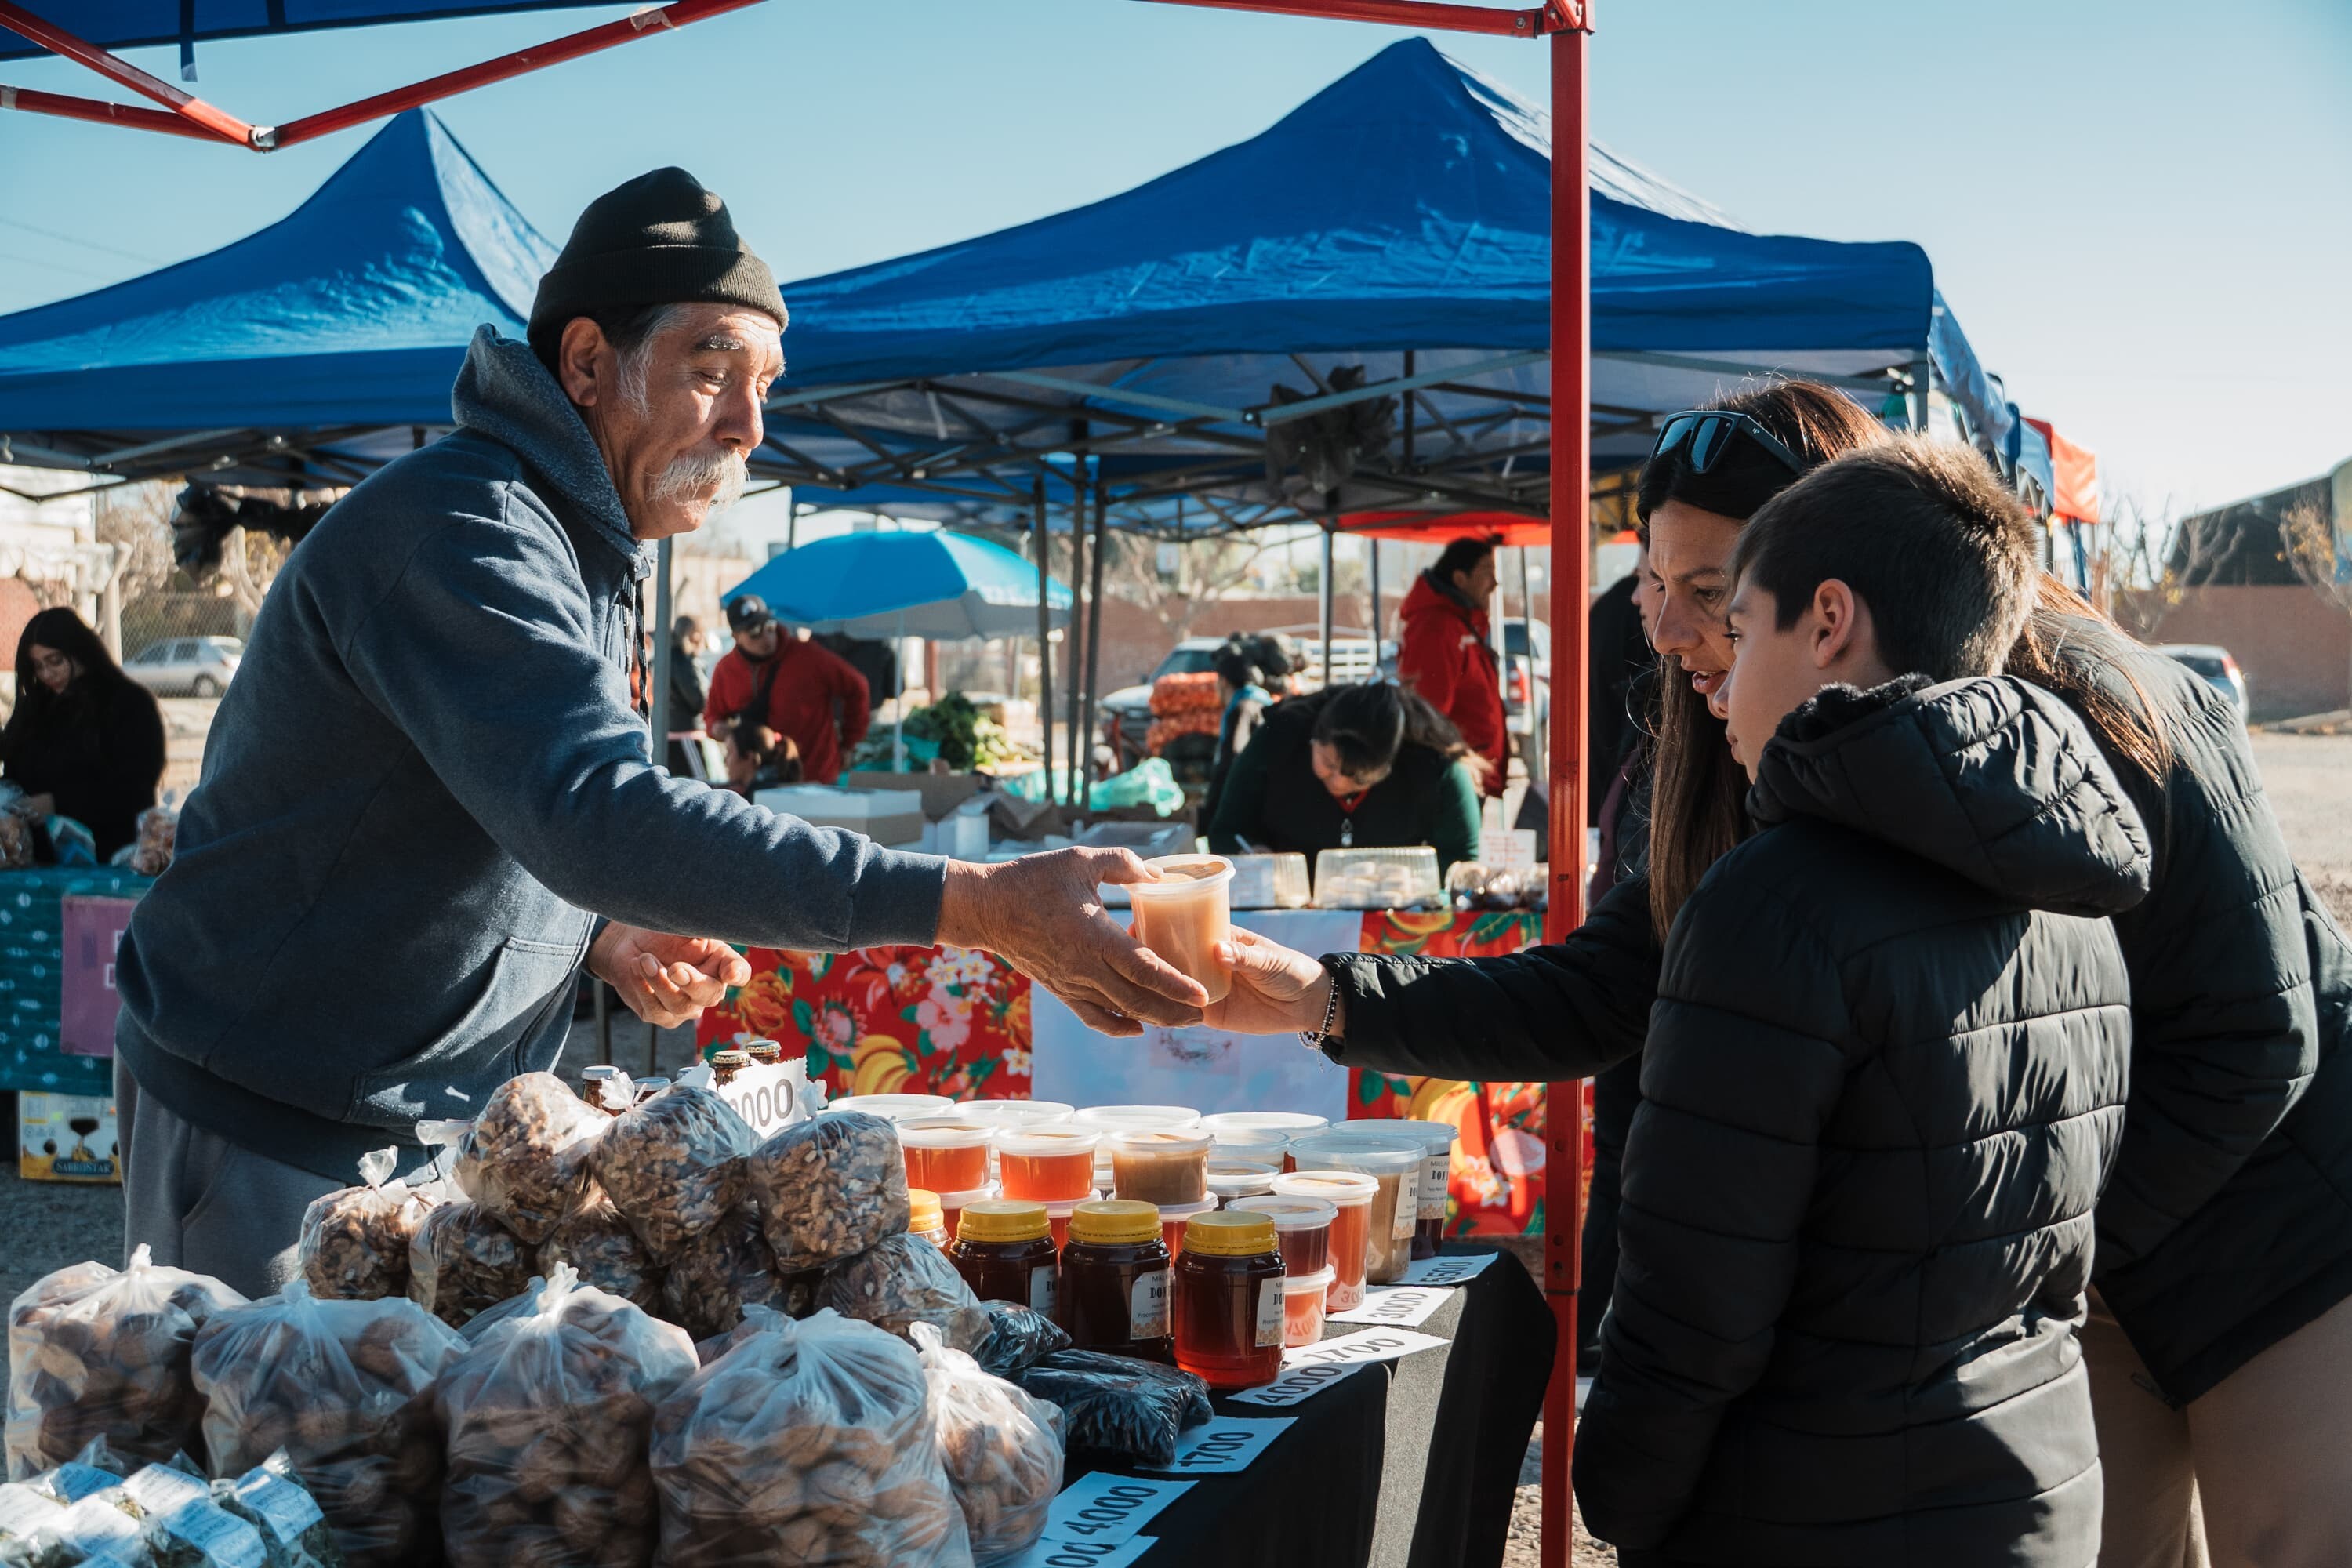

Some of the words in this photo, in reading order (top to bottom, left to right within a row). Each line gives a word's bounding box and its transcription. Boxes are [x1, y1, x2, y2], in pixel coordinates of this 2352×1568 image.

[729, 1079, 793, 1128] 000
[1419, 1261, 1474, 1283] 5500
[1254, 1367, 1343, 1403] 4000
